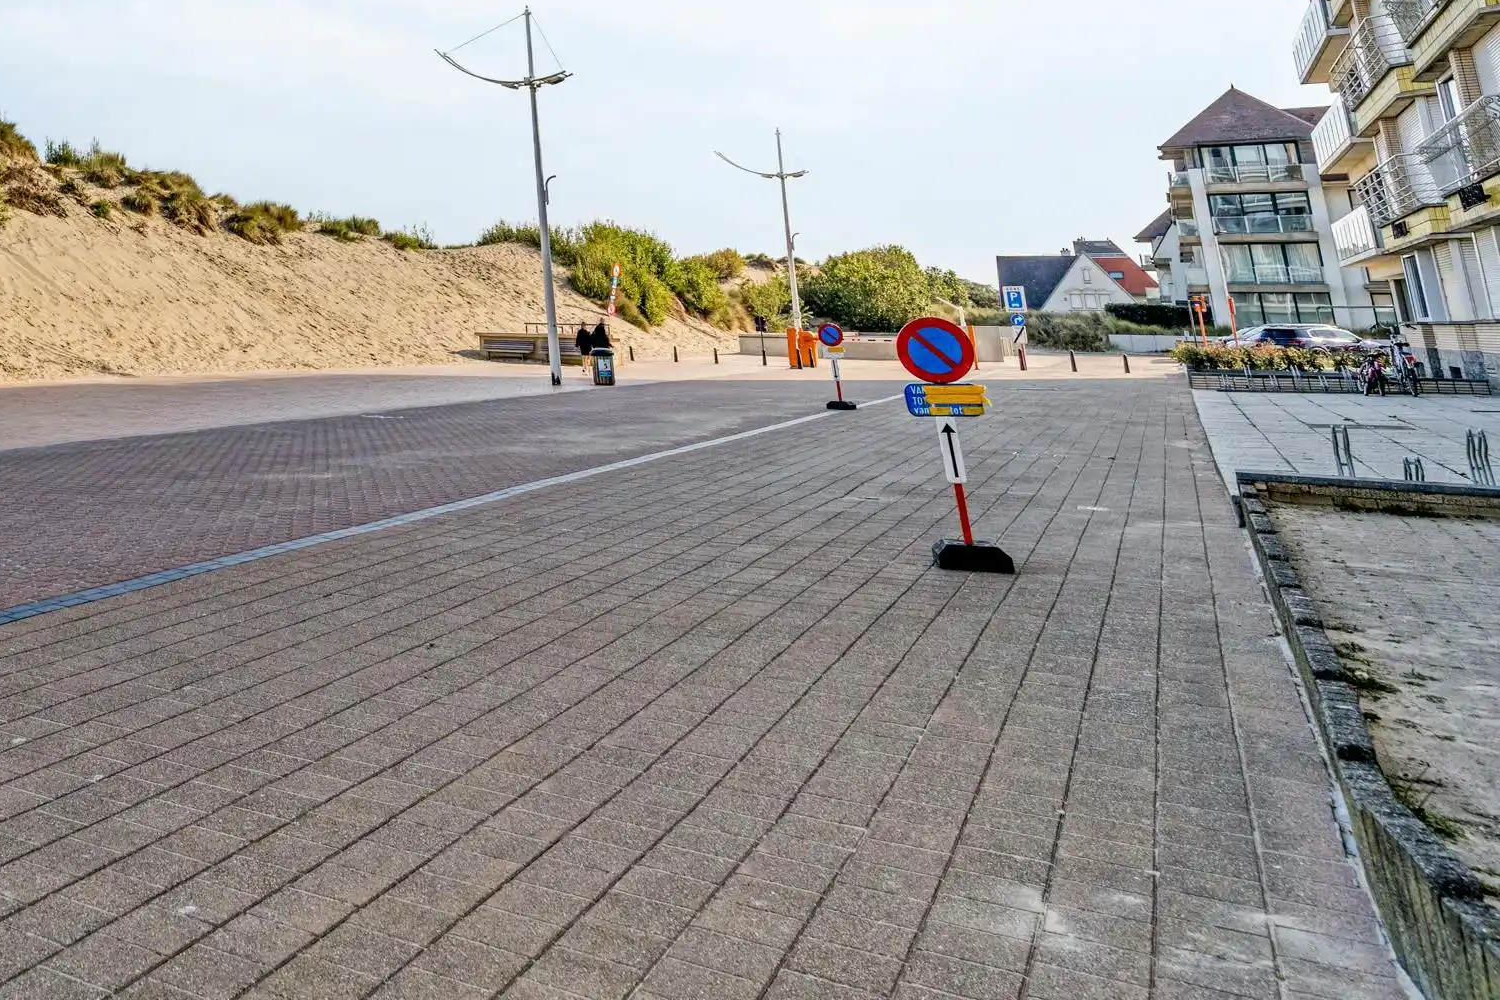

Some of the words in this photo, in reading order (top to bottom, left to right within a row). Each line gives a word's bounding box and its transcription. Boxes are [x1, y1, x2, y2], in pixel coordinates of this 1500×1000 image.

[1010, 292, 1018, 302] P
[913, 407, 930, 415] van
[949, 406, 964, 415] tot
